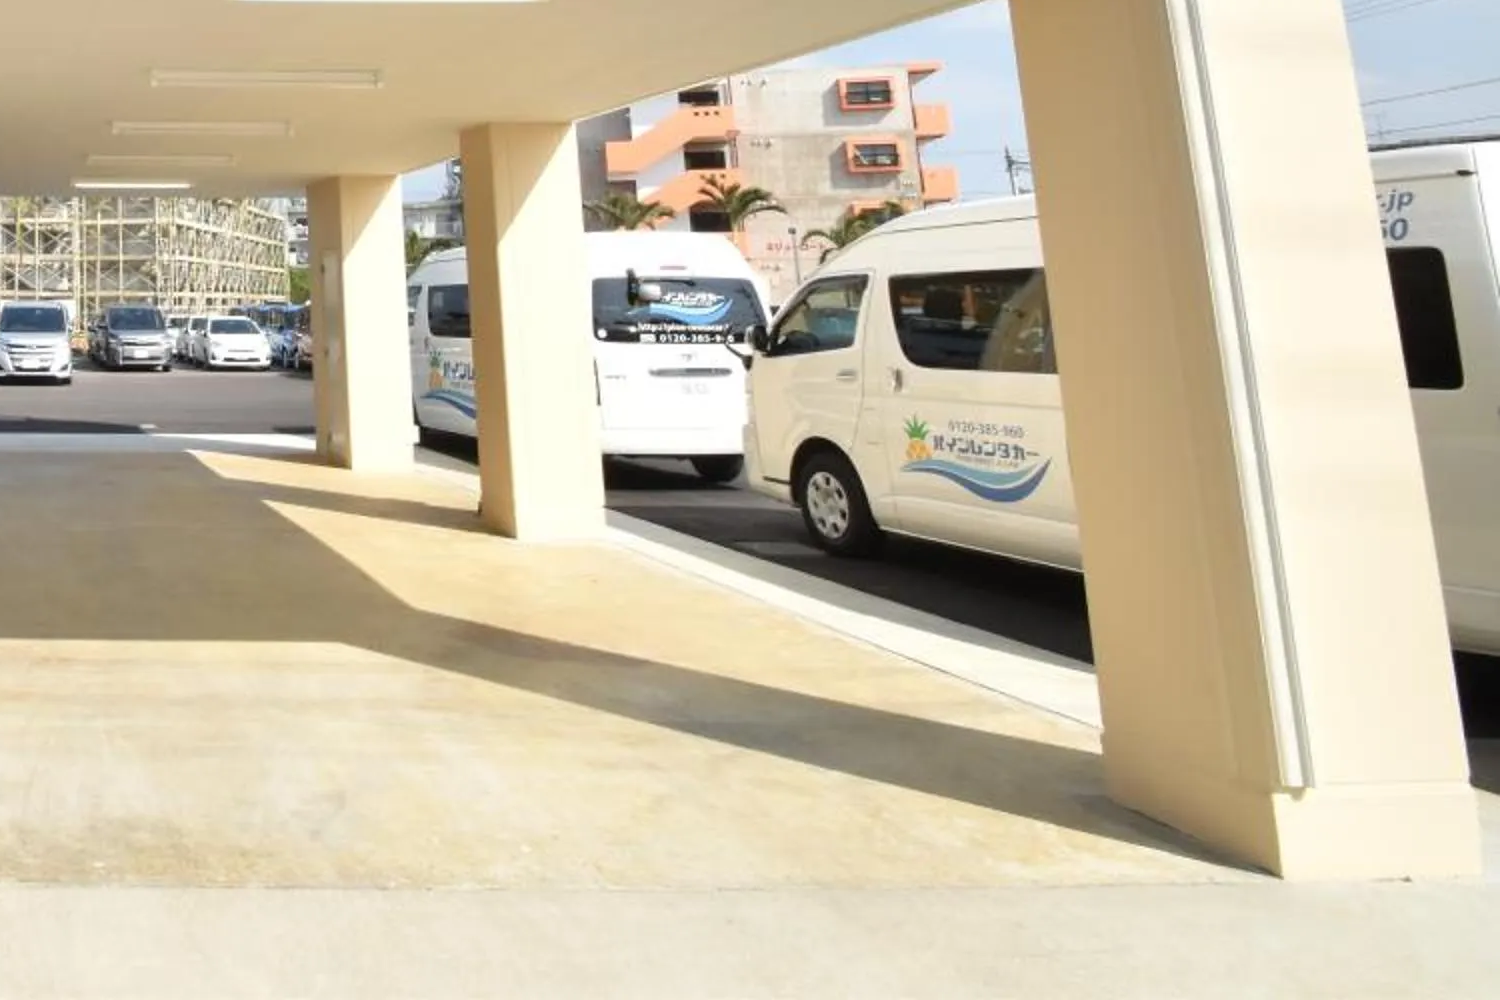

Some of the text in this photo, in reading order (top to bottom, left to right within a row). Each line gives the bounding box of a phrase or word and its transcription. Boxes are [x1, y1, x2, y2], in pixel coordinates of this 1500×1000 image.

[932, 435, 1041, 461] パインレンタカー
